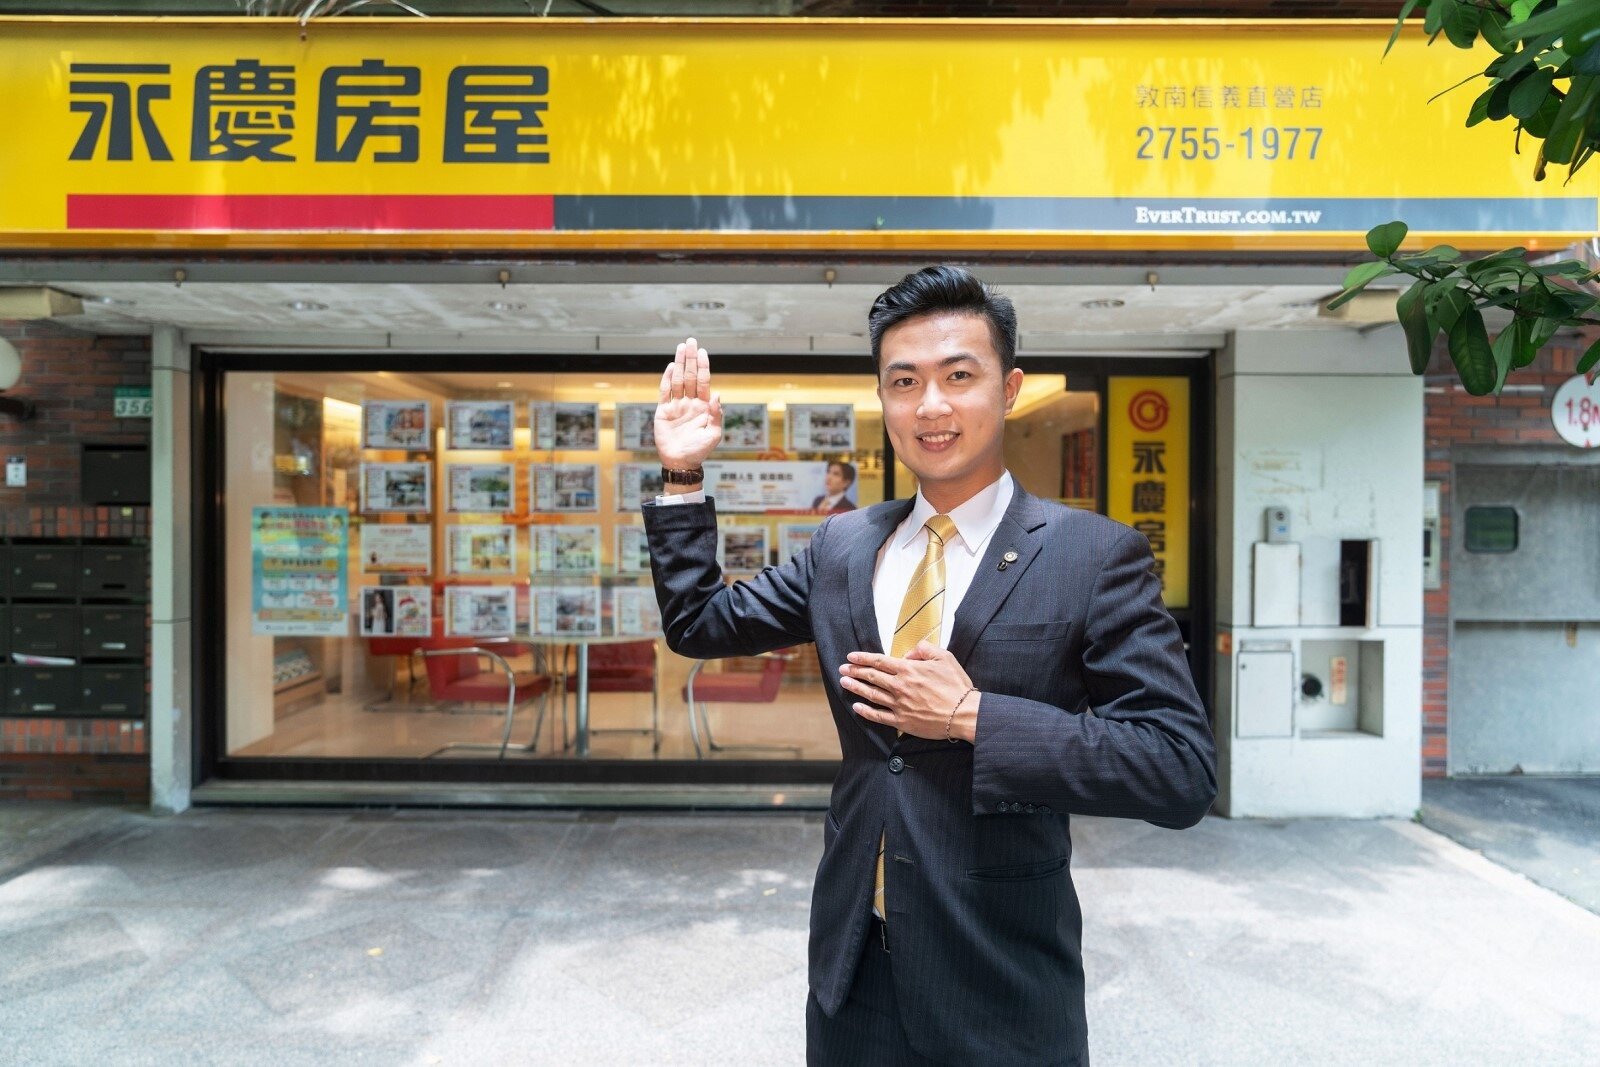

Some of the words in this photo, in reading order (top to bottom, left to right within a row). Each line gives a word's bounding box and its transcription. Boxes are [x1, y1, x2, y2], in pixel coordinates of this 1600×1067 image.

[69, 59, 550, 163] 永慶房屋
[1136, 85, 1324, 109] 敦南信義直營店
[1136, 126, 1324, 160] 2755-1977
